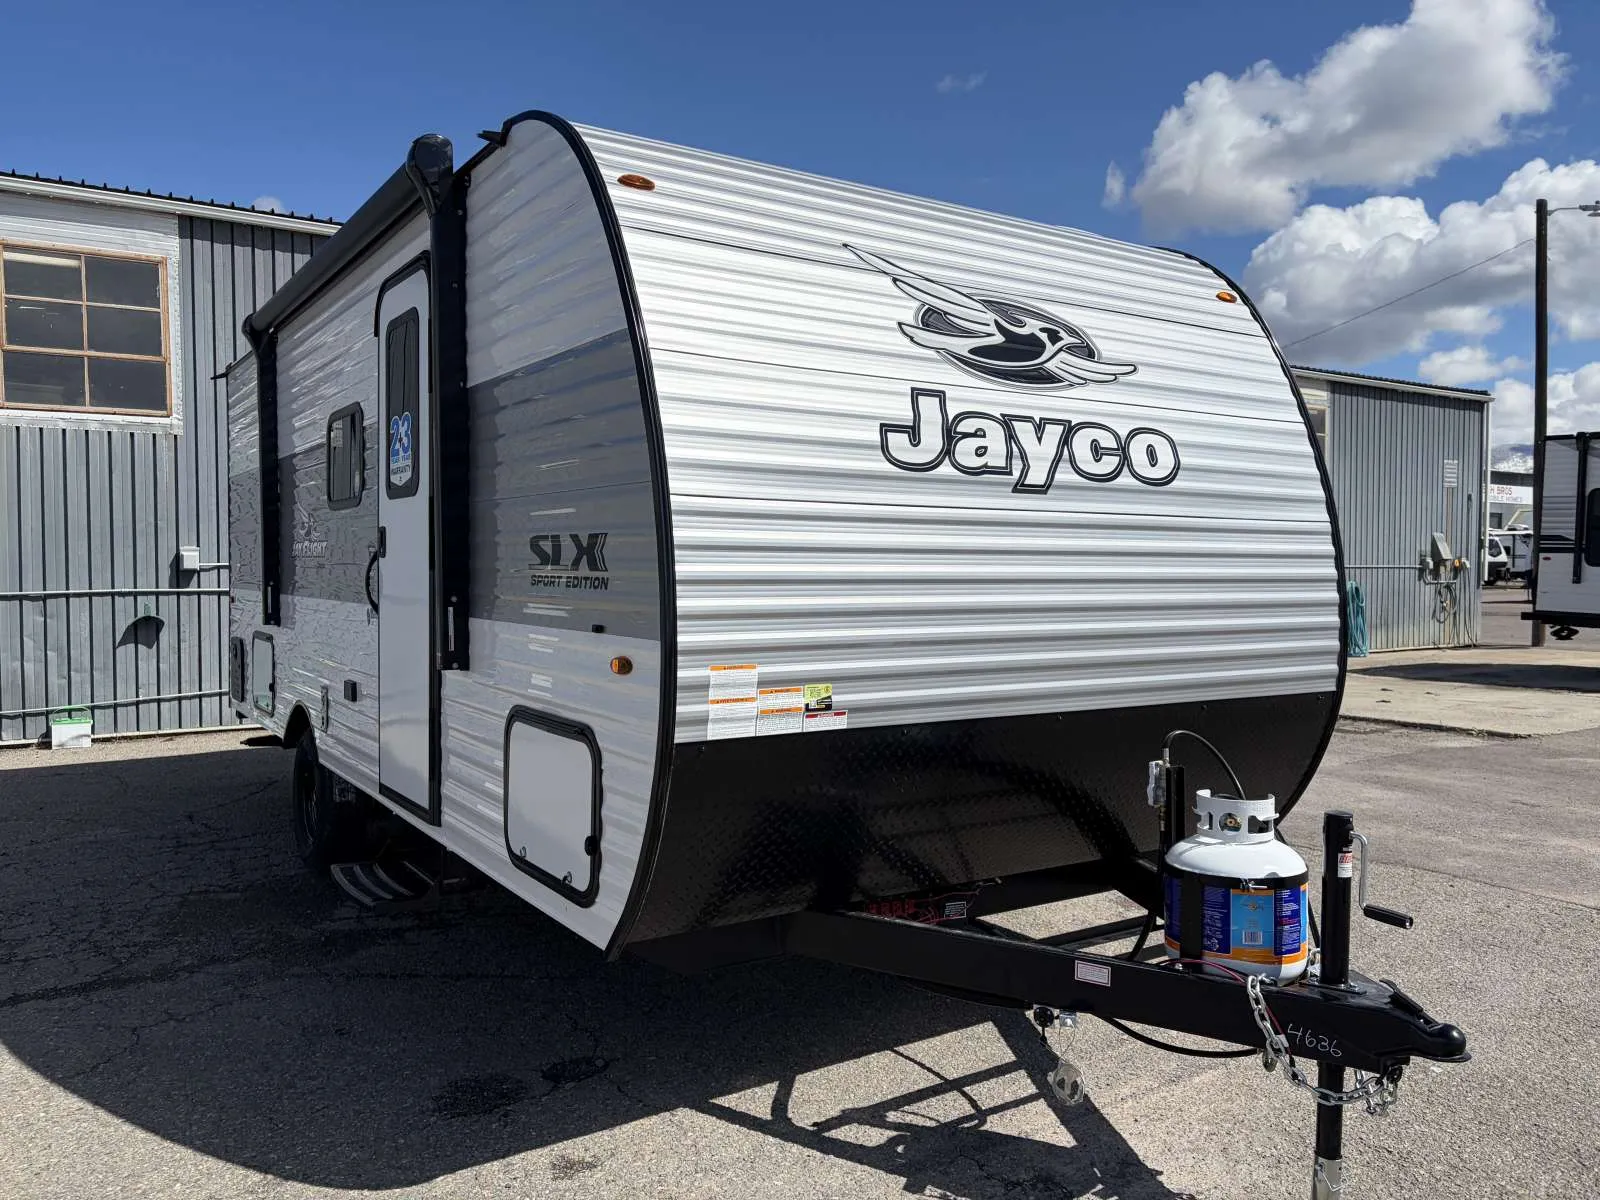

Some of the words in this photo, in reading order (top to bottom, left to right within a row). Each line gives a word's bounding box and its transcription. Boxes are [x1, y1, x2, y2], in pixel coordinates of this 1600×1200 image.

[880, 387, 1181, 495] Jayco
[528, 532, 609, 572] SLX
[530, 574, 562, 588] SPORT
[565, 576, 609, 591] EDITION
[1287, 1023, 1342, 1057] 4636
